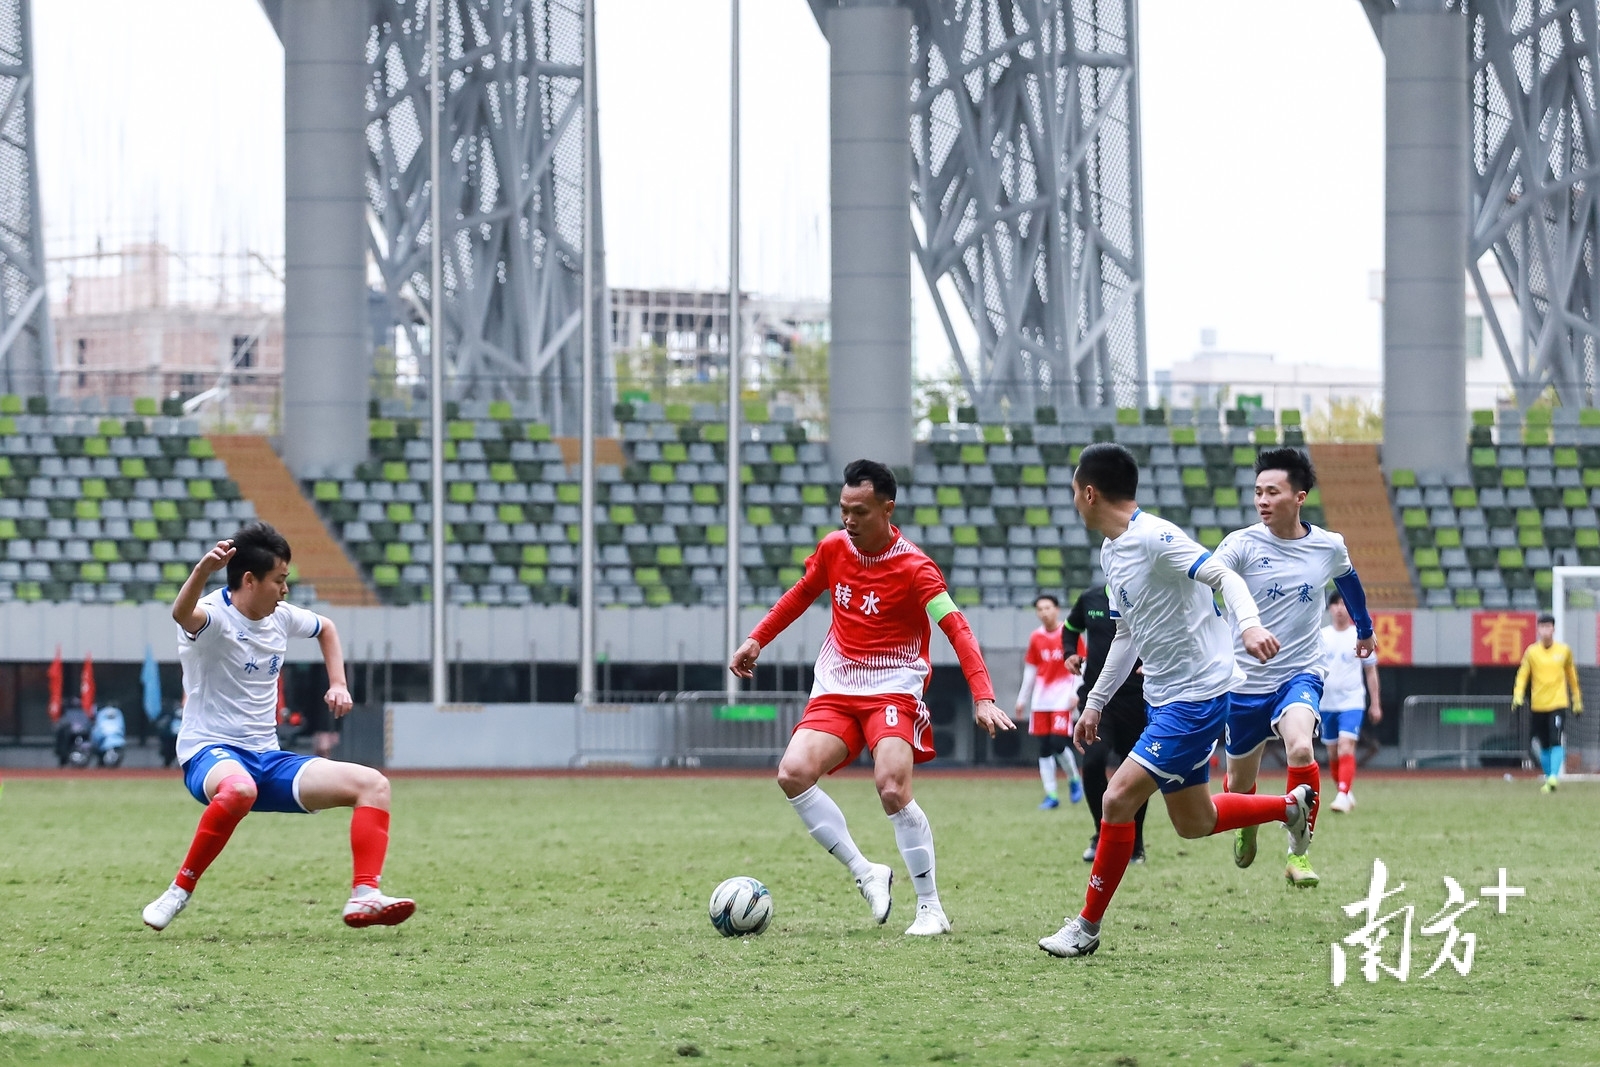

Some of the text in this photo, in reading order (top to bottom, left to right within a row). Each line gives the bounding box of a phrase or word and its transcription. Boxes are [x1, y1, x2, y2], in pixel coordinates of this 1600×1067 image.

[835, 582, 880, 615] 转水
[1266, 582, 1313, 603] 水寨
[244, 654, 280, 675] 水寨
[885, 705, 898, 727] 8
[210, 747, 231, 759] 5
